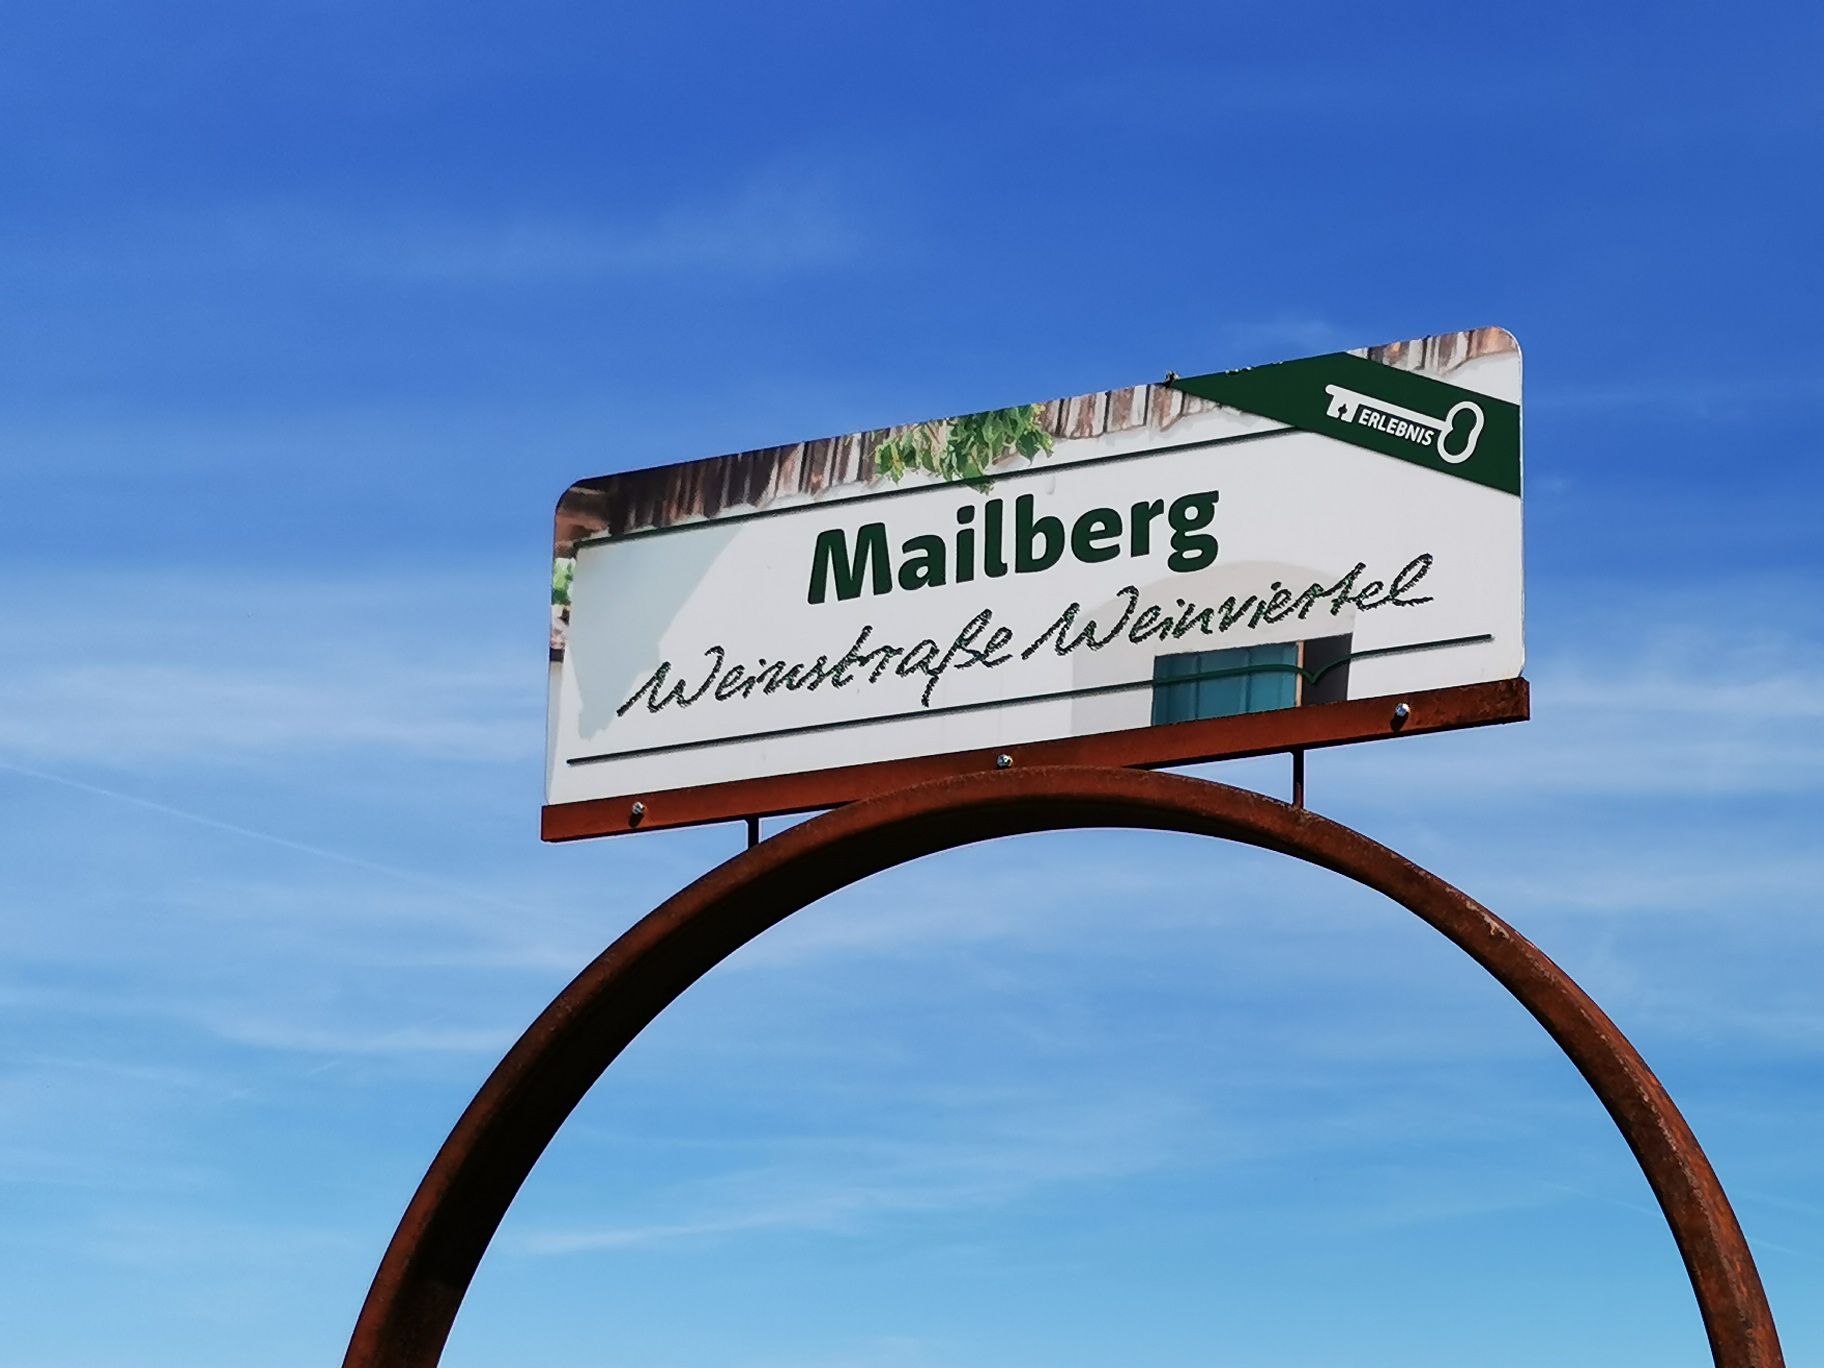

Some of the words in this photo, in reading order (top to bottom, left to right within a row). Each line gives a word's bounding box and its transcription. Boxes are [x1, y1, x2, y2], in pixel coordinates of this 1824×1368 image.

[1358, 409, 1435, 446] ERLEBNIS
[808, 490, 1219, 604] Mailberg
[616, 608, 1014, 717] Weinstraße
[1021, 553, 1434, 661] Weinviertel
